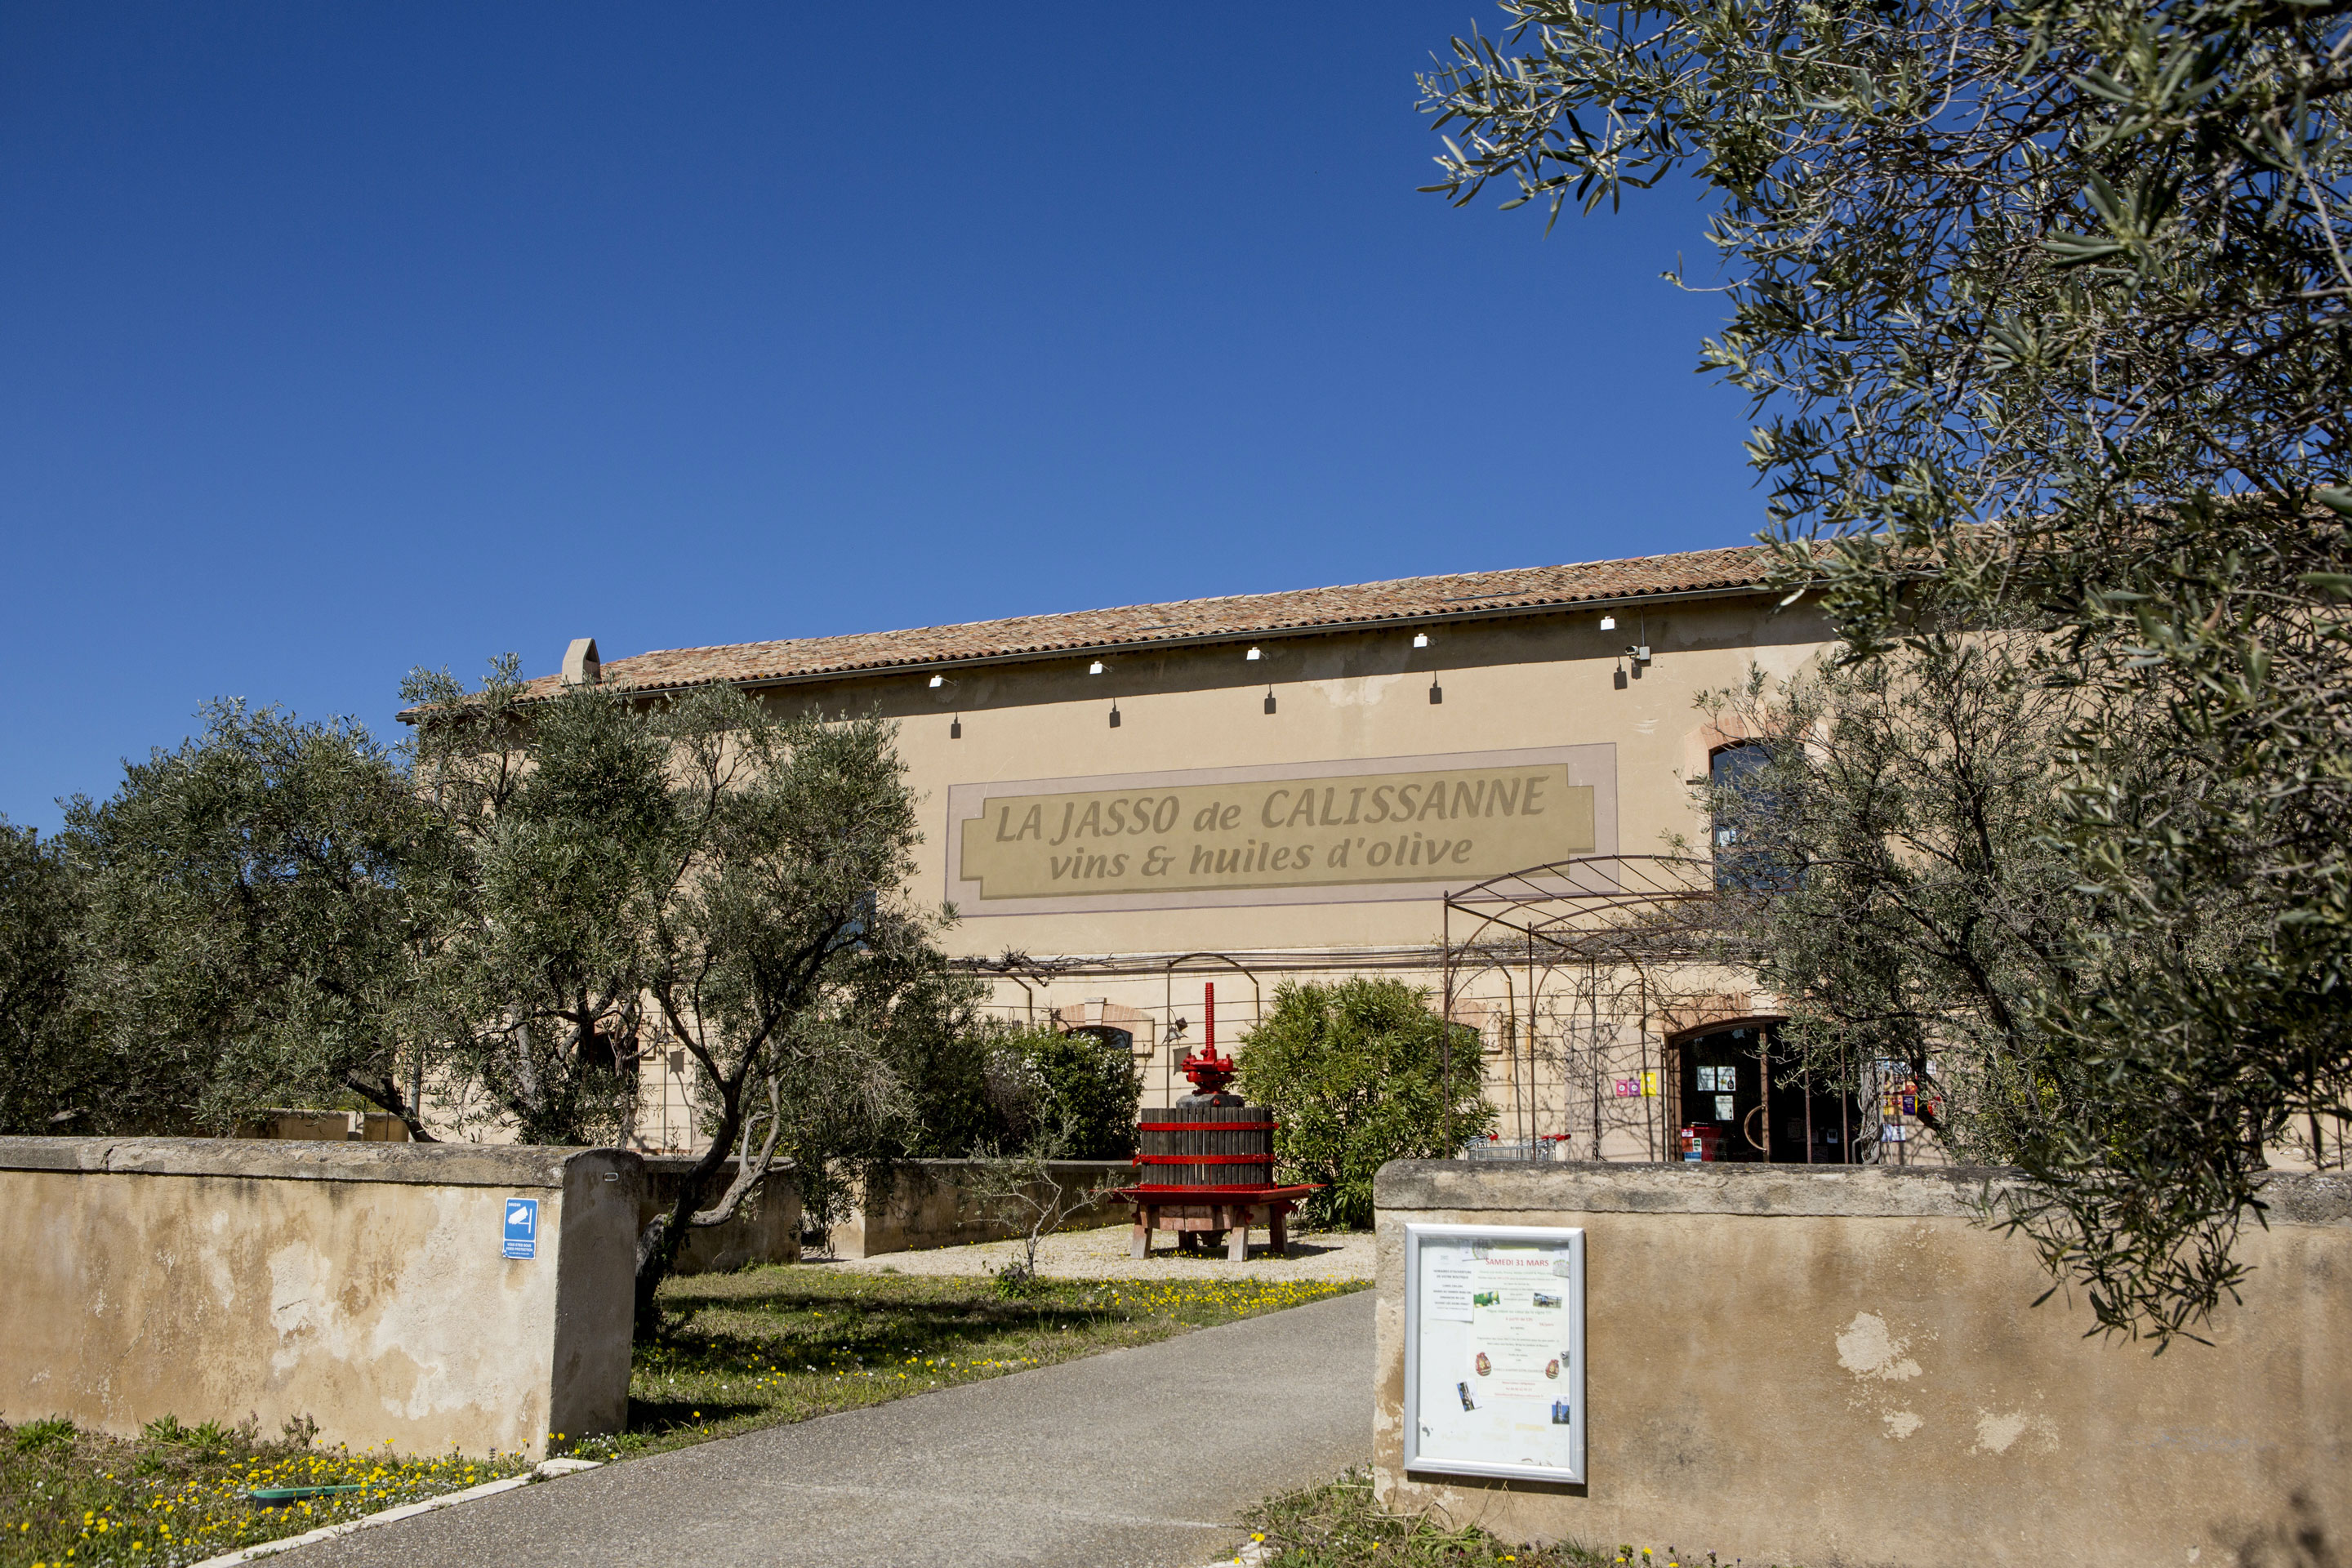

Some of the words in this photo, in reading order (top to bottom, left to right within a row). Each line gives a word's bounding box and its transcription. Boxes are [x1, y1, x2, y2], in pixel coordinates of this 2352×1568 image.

[996, 804, 1042, 843] LA
[1049, 795, 1181, 846] JASSO
[1192, 801, 1242, 832] de
[1260, 774, 1550, 829] CALISSANNE
[1051, 846, 1129, 880] vins
[1141, 845, 1176, 876] &
[1188, 839, 1314, 875] huiles
[1326, 831, 1473, 869] d'olive
[1486, 1258, 1514, 1267] SAMEDI
[1516, 1258, 1525, 1267] 31
[1526, 1259, 1549, 1267] MARS
